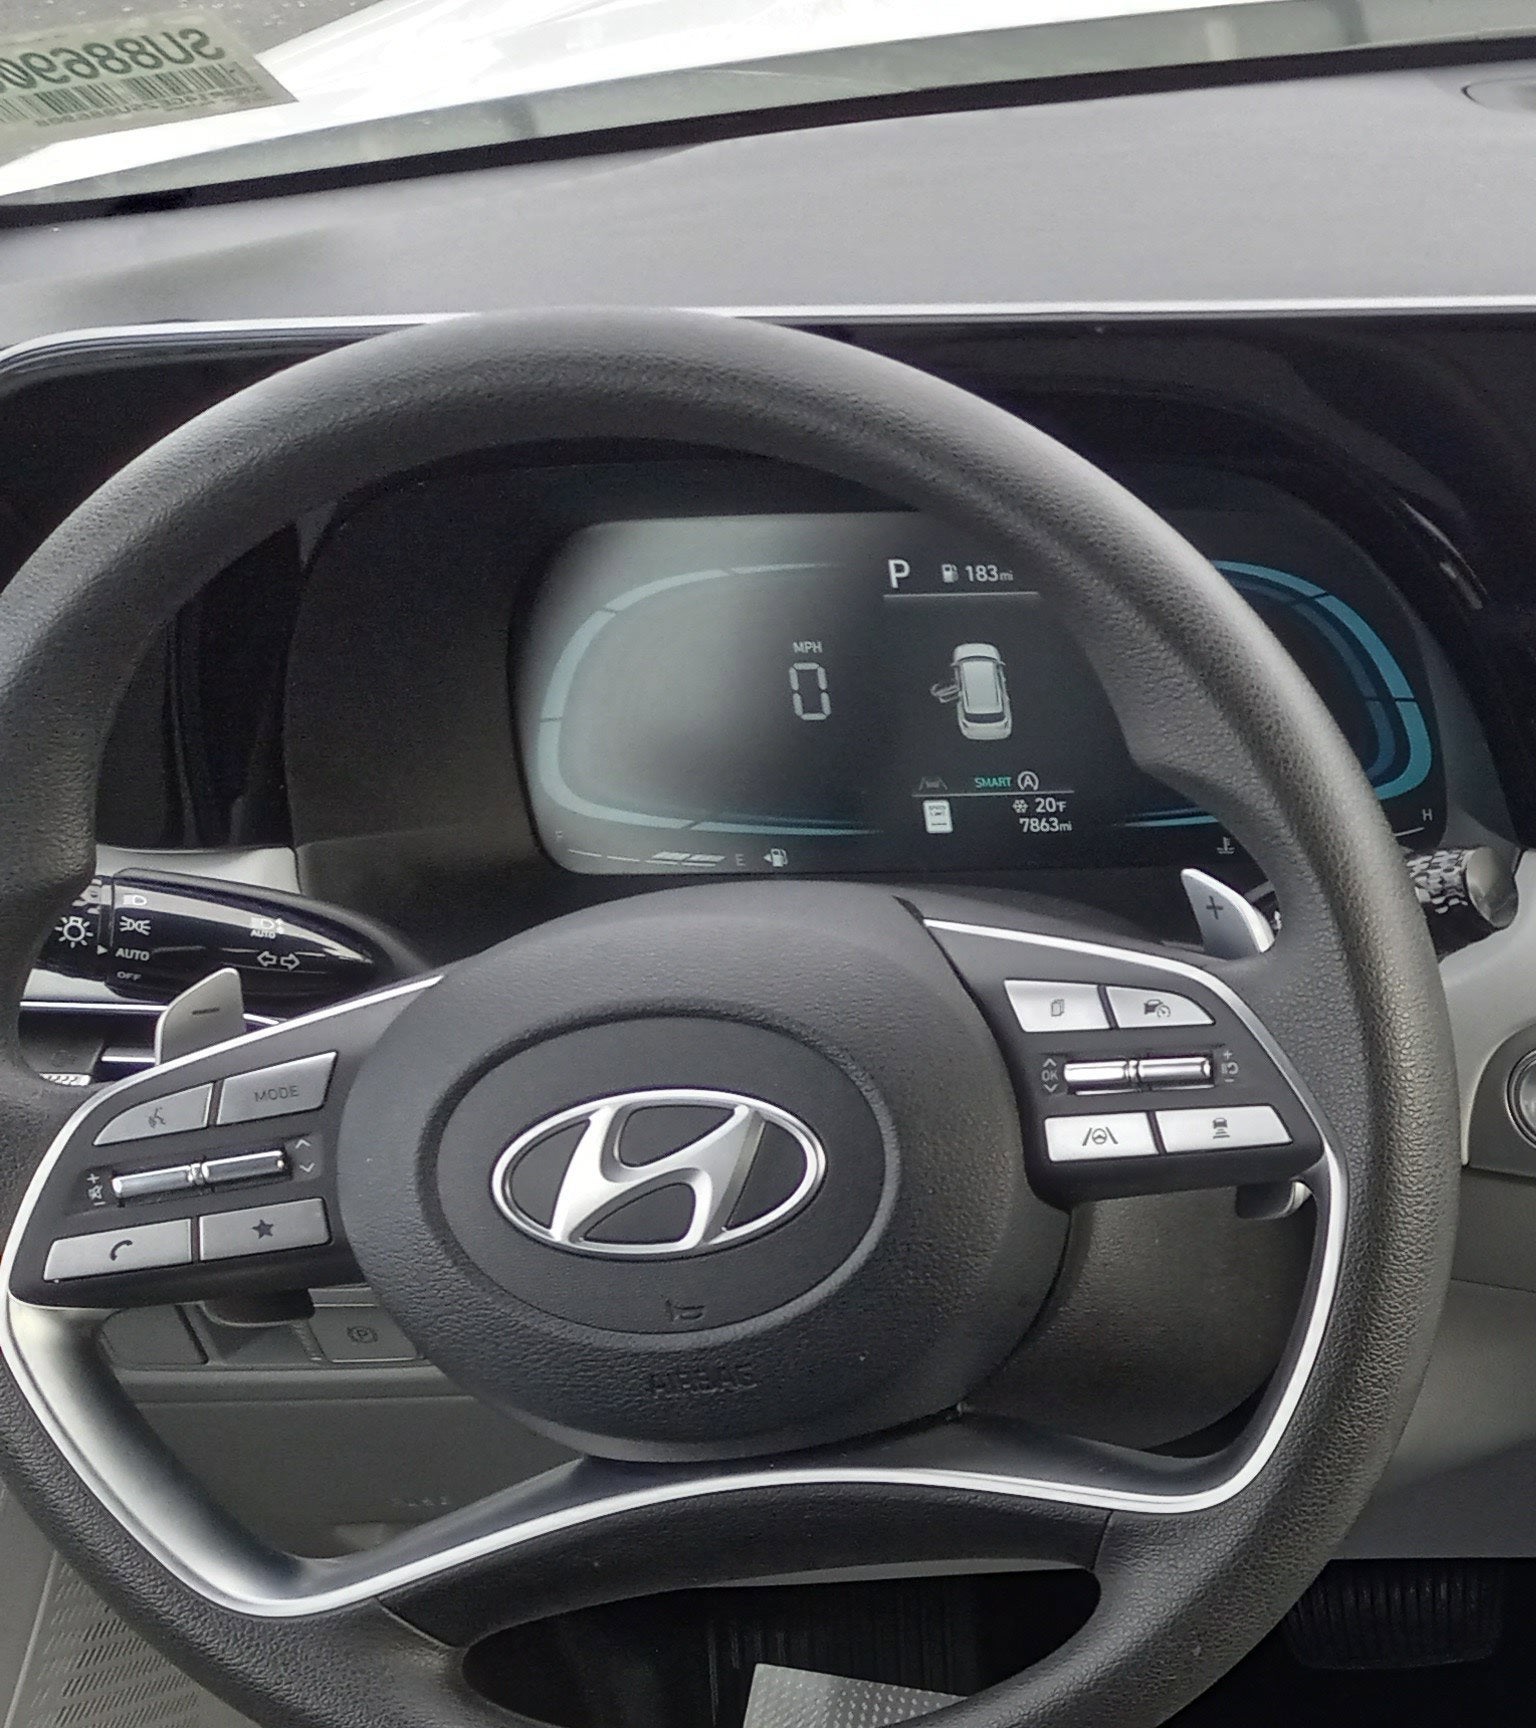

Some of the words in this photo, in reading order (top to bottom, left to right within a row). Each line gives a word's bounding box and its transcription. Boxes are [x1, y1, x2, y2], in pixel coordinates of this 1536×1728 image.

[888, 559, 910, 588] P
[792, 641, 822, 653] MPH
[788, 662, 831, 721] 0
[974, 776, 1011, 789] SMART
[1422, 809, 1433, 822] H
[250, 929, 276, 939] AUTO
[115, 948, 150, 962] AUTO
[116, 971, 142, 981] OFF
[1041, 1070, 1059, 1082] OK
[254, 1083, 300, 1102] MODE
